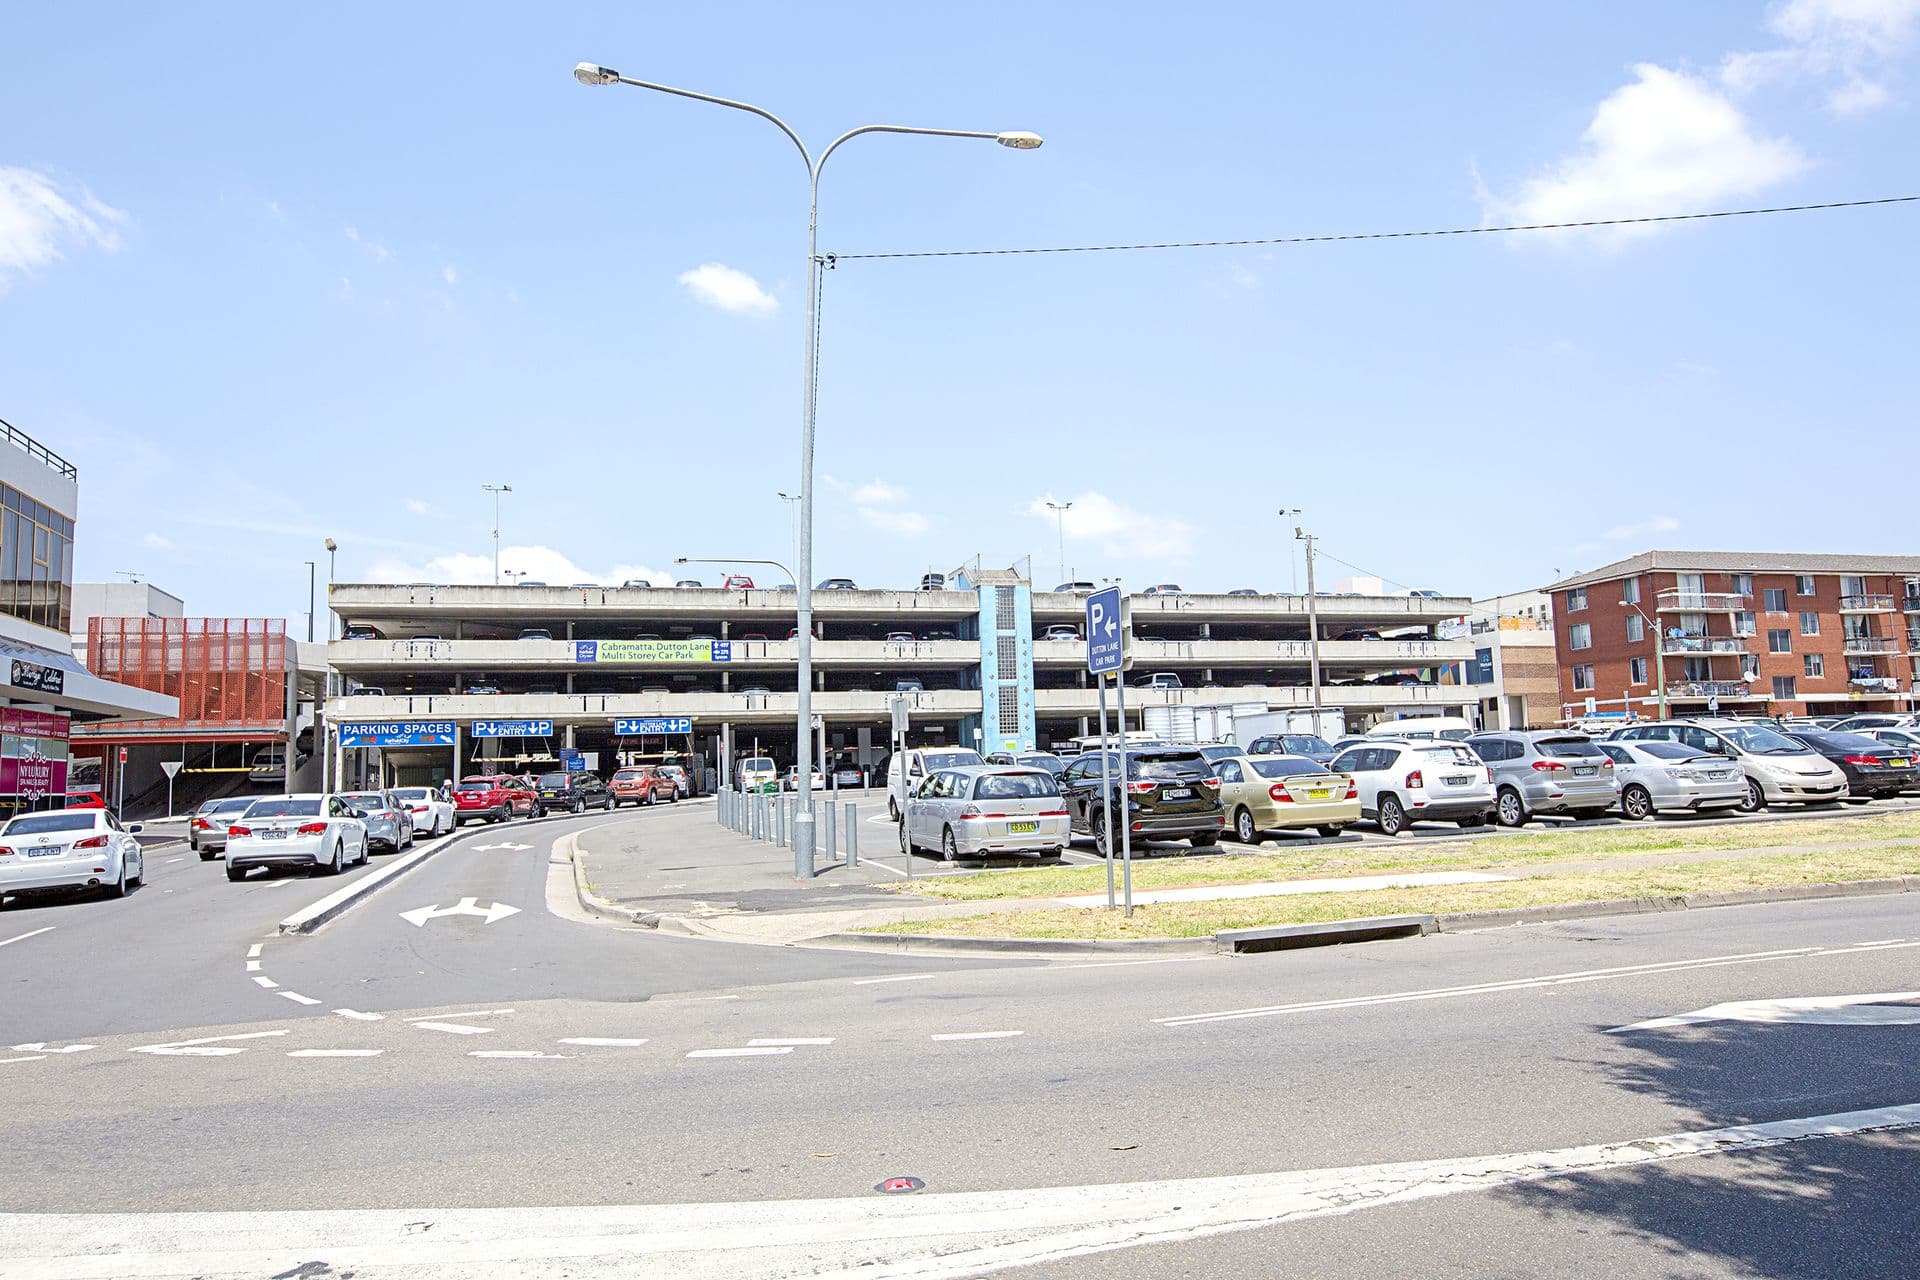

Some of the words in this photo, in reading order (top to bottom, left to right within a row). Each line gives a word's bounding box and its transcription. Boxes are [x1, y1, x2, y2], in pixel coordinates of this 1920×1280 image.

[1091, 603, 1104, 637] P
[1091, 644, 1107, 655] DUTTON
[1107, 641, 1119, 652] LANE
[628, 652, 656, 661] Storey
[658, 651, 673, 659] Car
[675, 651, 694, 659] Park
[1095, 657, 1105, 666] CAR
[1104, 654, 1116, 665] PARK
[343, 724, 399, 735] PARKING
[403, 723, 452, 734] SPACES
[475, 722, 487, 736] P
[498, 728, 527, 736] ENTRY
[538, 721, 550, 735] P
[617, 720, 628, 733] P
[640, 725, 667, 733] ENTRY
[678, 719, 690, 732] P
